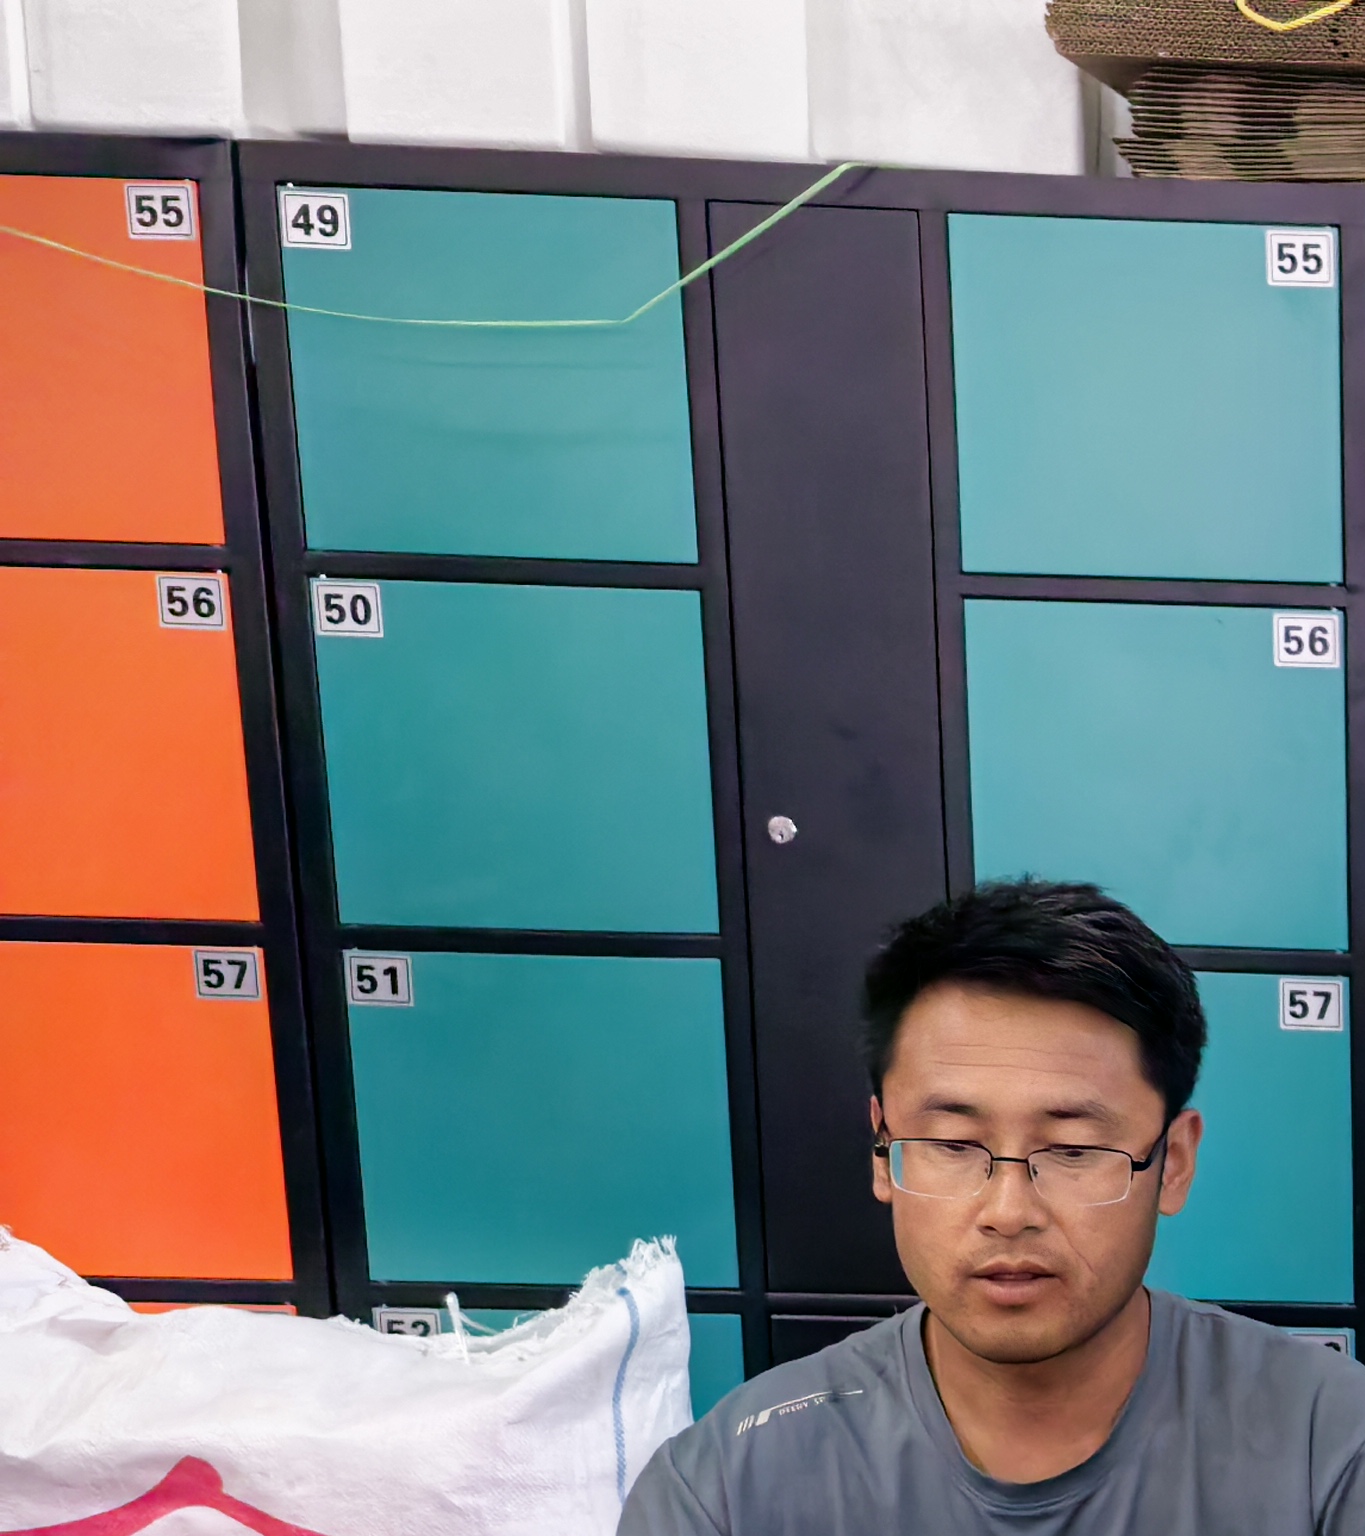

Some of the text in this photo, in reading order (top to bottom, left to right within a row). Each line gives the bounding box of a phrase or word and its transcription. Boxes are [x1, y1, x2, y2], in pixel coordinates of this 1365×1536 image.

[134, 194, 186, 229] 55
[290, 203, 341, 239] 49
[1276, 242, 1324, 275] 55
[165, 586, 217, 620] 56
[323, 593, 373, 626] 50
[1282, 624, 1330, 658] 56
[201, 959, 250, 991] 57
[356, 964, 401, 997] 51
[1287, 991, 1333, 1021] 57
